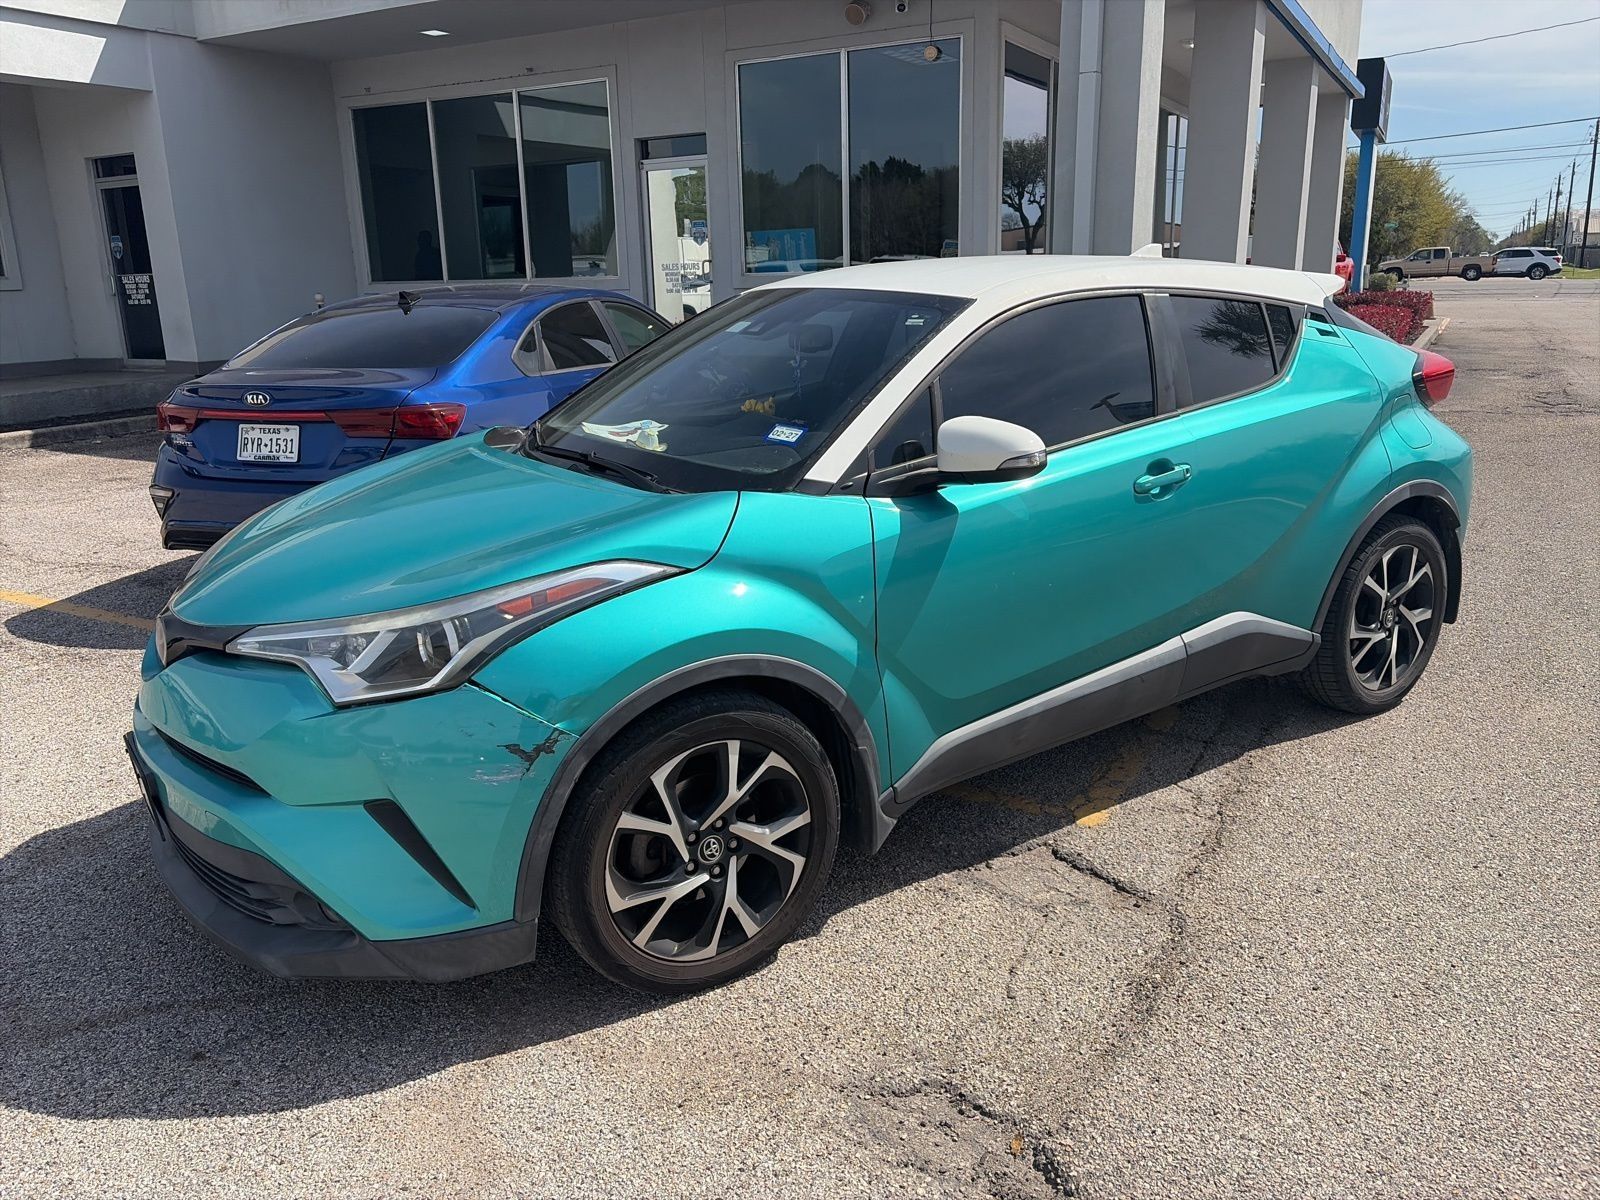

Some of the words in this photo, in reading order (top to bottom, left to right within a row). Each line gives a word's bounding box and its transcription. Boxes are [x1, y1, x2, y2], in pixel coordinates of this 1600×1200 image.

[661, 263, 679, 271] SALES
[680, 262, 700, 270] HOURS
[122, 276, 135, 284] SALES
[135, 275, 150, 283] HOURS
[246, 395, 265, 404] KIA
